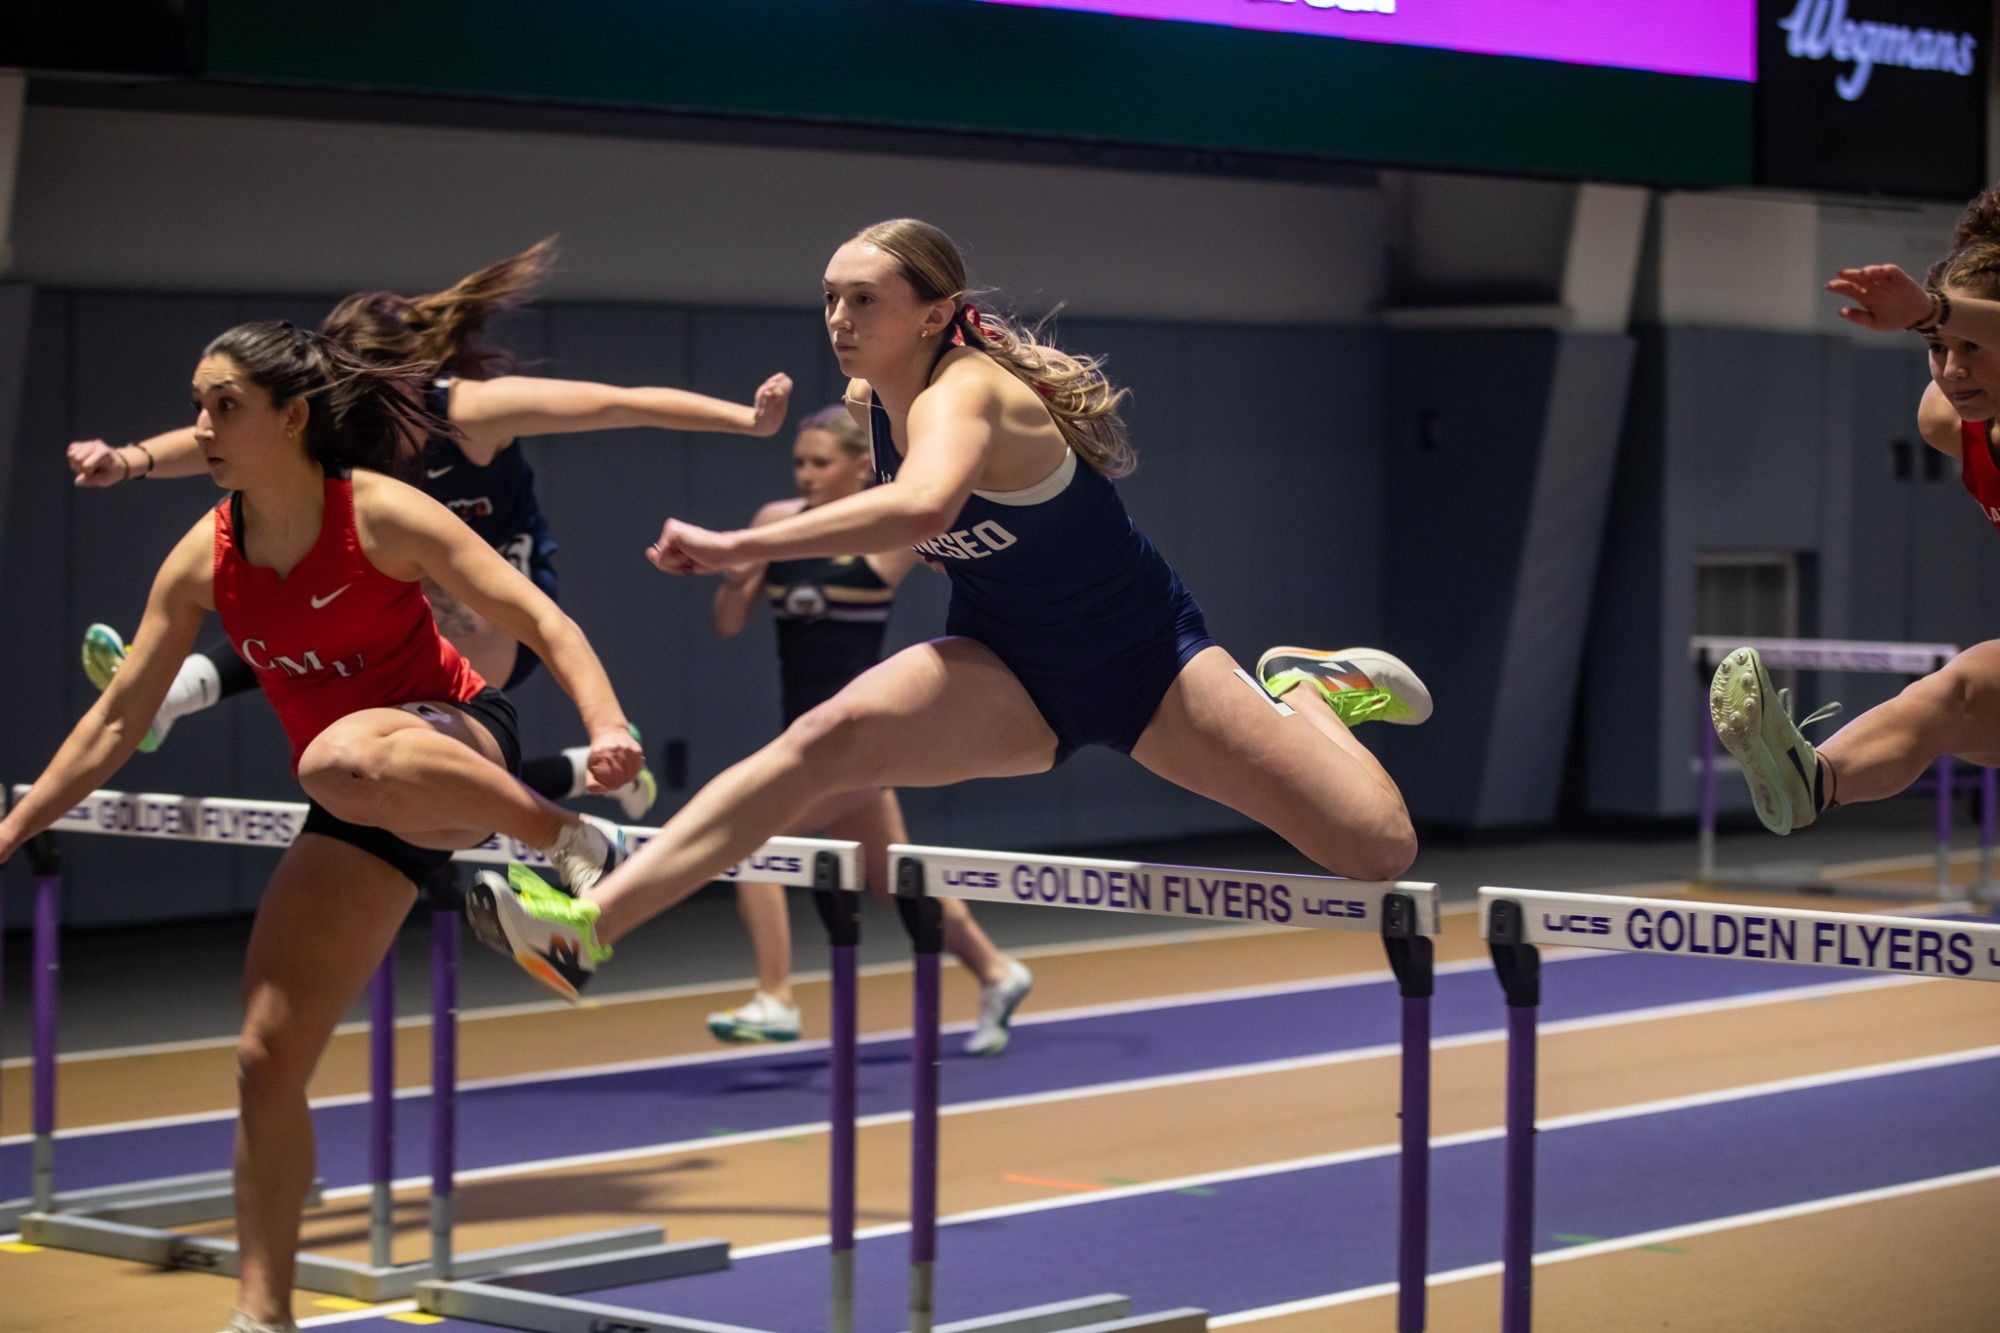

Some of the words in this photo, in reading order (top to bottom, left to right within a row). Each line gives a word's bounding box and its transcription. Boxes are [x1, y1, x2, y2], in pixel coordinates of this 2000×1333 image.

[1777, 0, 1977, 101] Wegmans
[911, 519, 1018, 559] NESEO
[241, 638, 365, 678] CMU
[99, 800, 197, 836] GOLDEN
[203, 807, 294, 844] FLYERS
[748, 853, 802, 874] UCS
[942, 869, 999, 888] UCS
[1011, 864, 1151, 911] GOLDEN
[1162, 875, 1292, 923] FLYERS
[1302, 898, 1367, 919] UCS
[1542, 912, 1611, 935] UCS
[1626, 907, 1797, 961] GOLDEN
[1813, 921, 1974, 976] FLYERS
